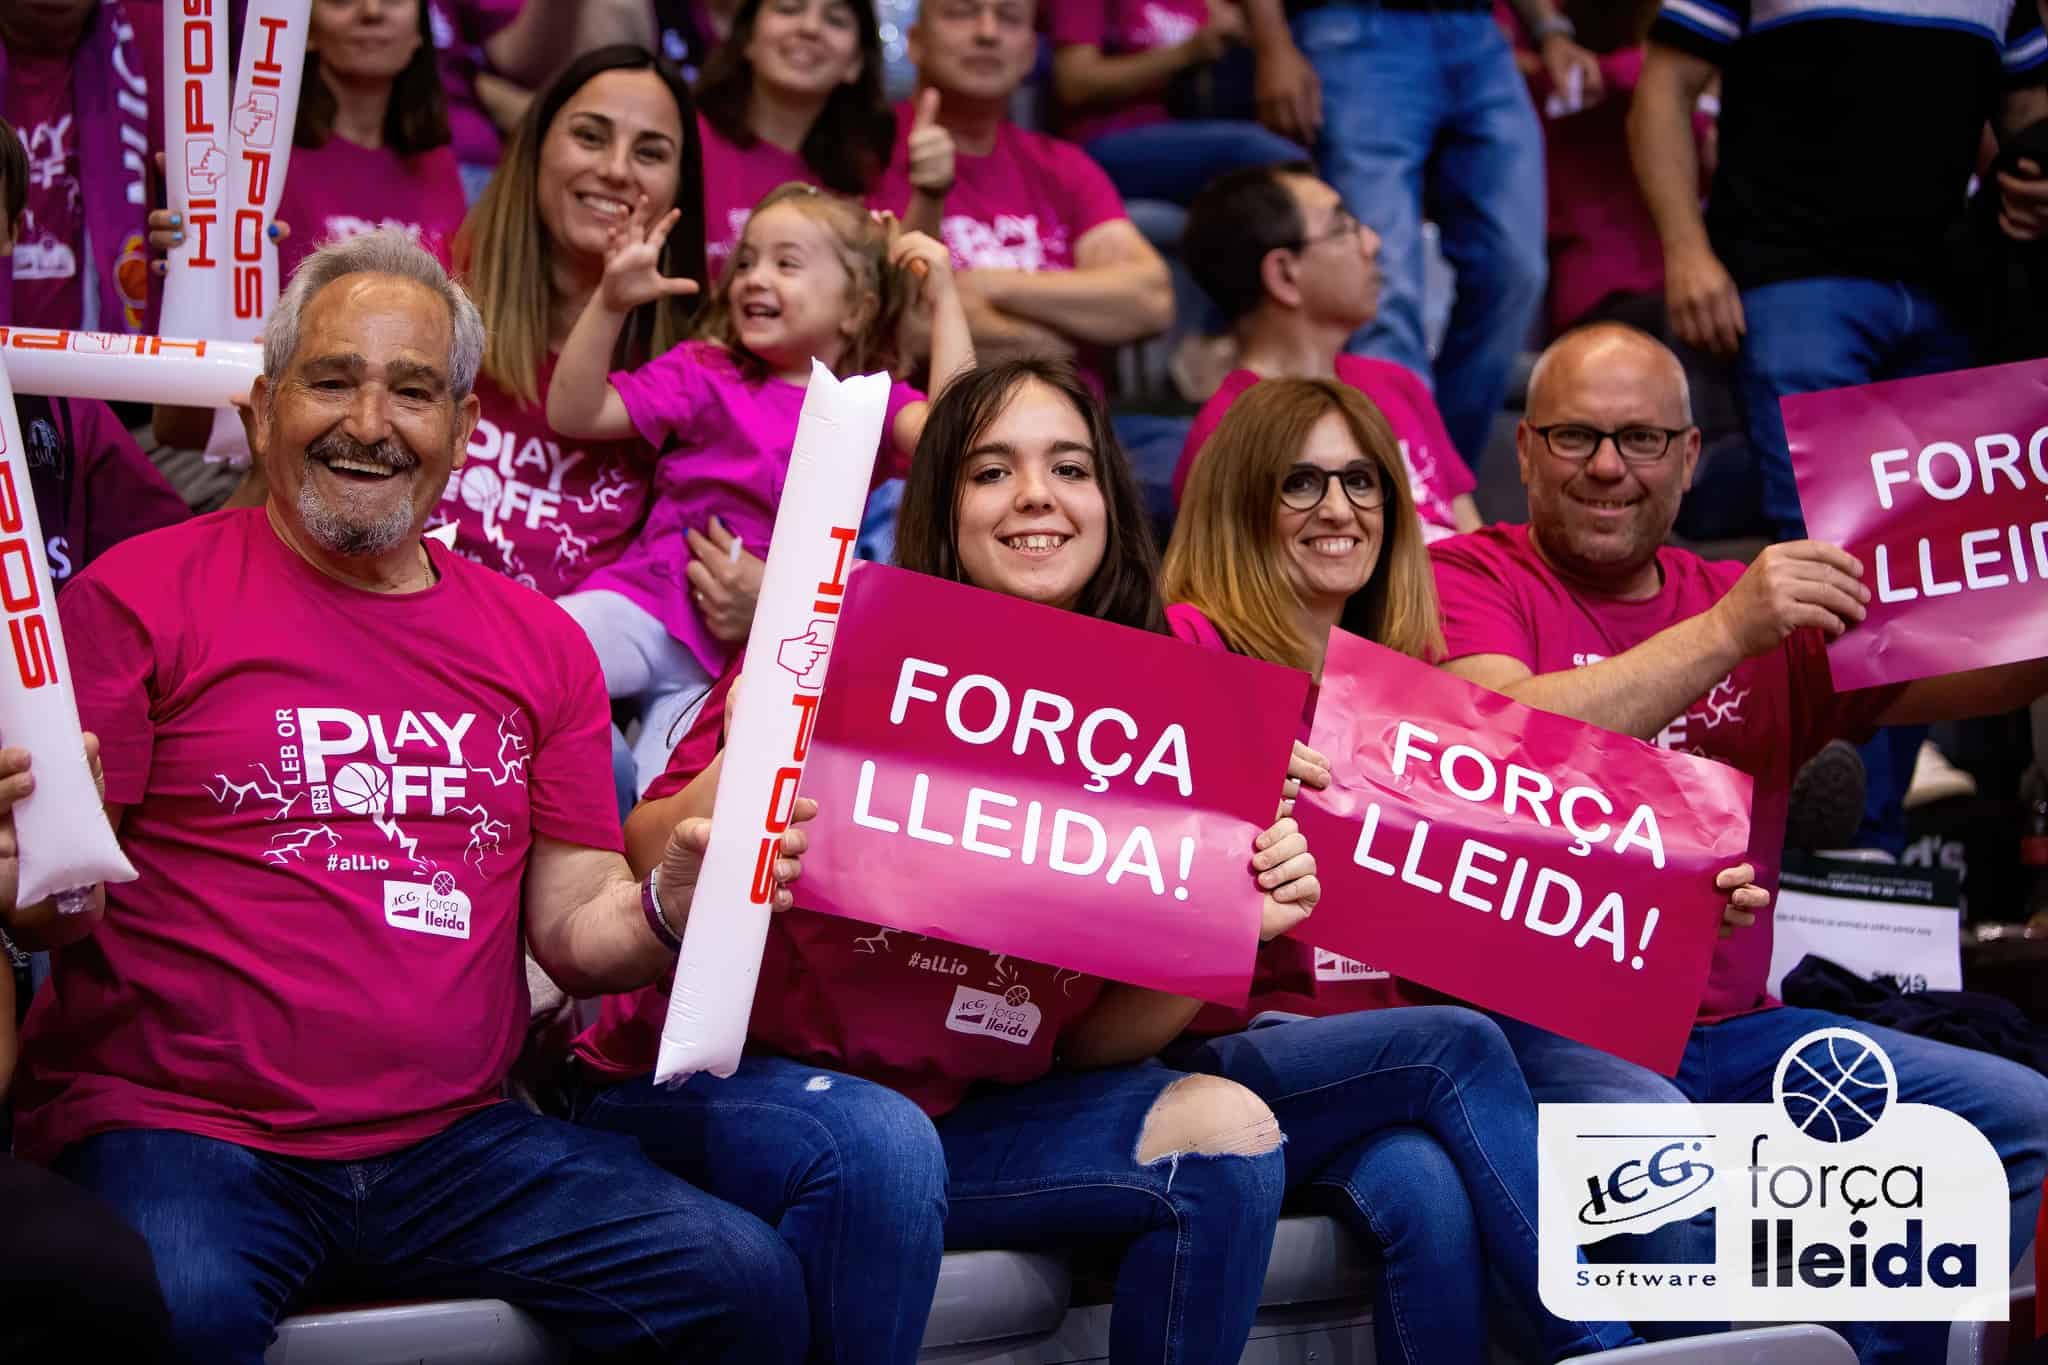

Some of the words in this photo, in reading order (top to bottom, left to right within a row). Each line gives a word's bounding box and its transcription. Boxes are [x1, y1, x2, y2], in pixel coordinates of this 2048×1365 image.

[276, 708, 294, 737] OR
[889, 656, 1194, 798] FORÇA
[297, 707, 477, 784] PLAY
[280, 744, 301, 785] LEB
[313, 789, 329, 799] 22
[332, 762, 467, 817] OFF
[1391, 720, 1666, 869] FORÇA
[314, 802, 330, 812] 23
[853, 759, 1196, 901] LLEIDA!
[327, 853, 391, 872] #alLio
[1353, 803, 1661, 971] LLEIDA!
[425, 892, 459, 913] força
[425, 911, 466, 931] lleida
[908, 952, 969, 976] #alLio
[985, 1017, 1029, 1038] lleida
